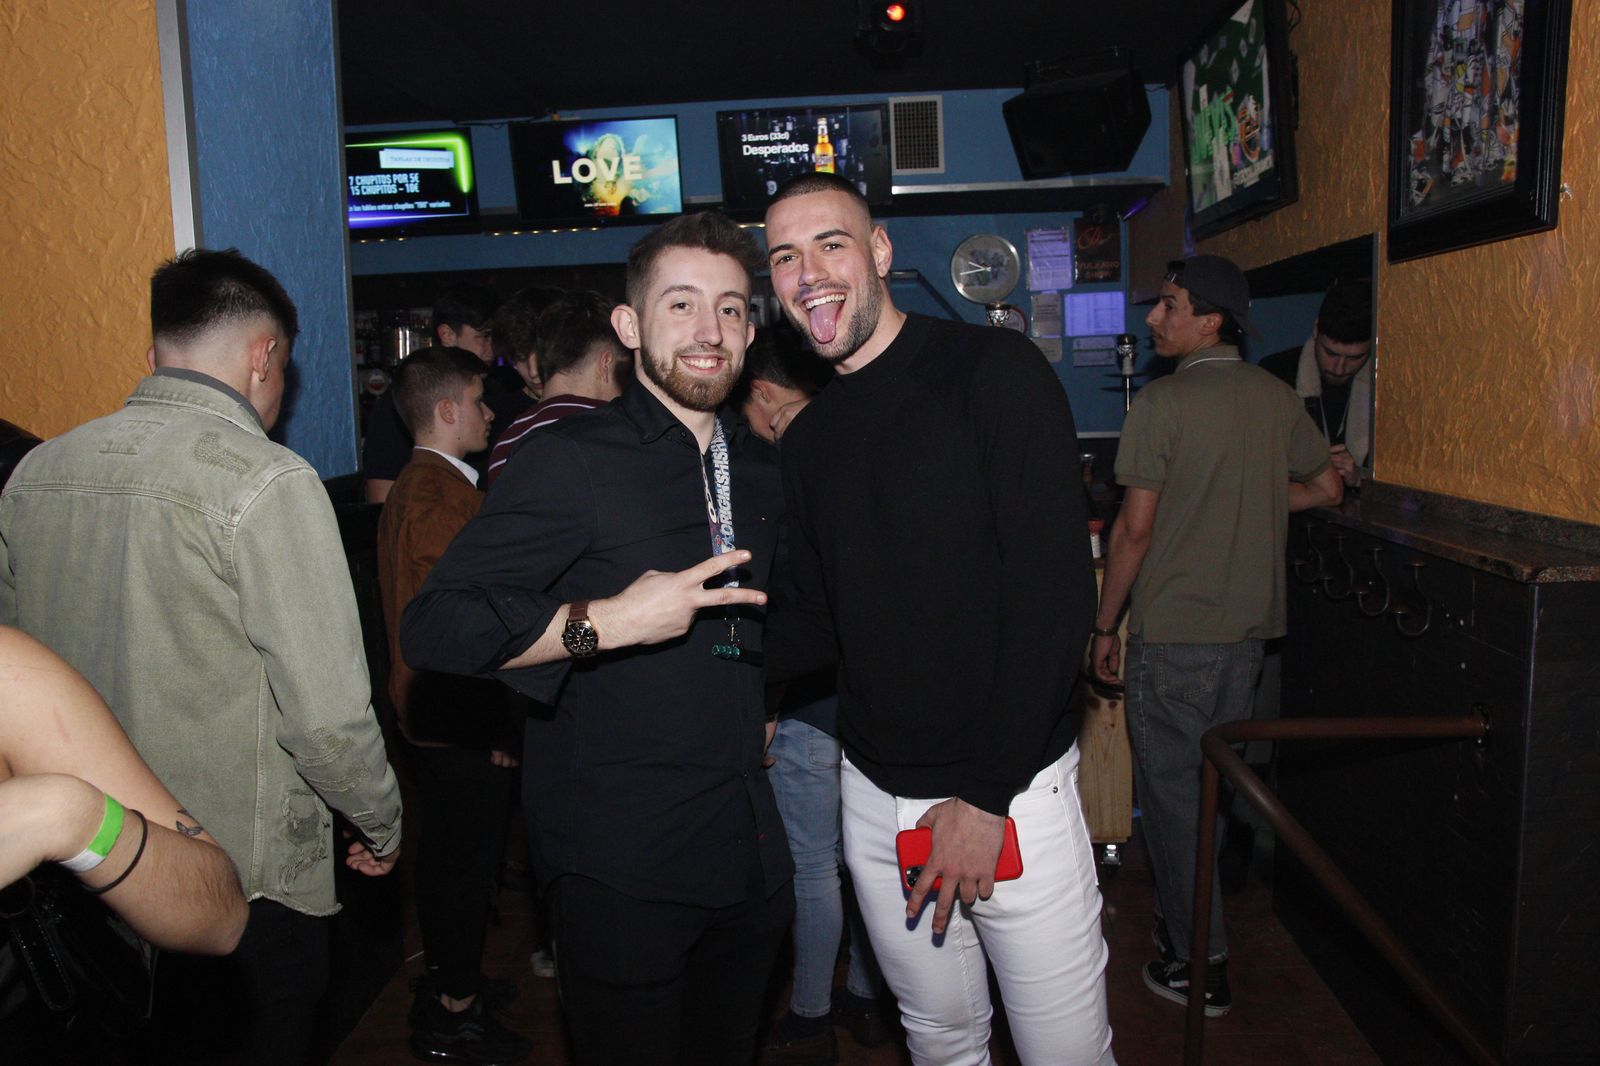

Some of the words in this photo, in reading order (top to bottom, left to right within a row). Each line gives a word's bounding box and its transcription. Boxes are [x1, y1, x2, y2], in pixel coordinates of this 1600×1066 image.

[741, 133, 748, 142] 3
[748, 133, 769, 142] Euros
[769, 131, 790, 141] (33cl)
[742, 141, 810, 158] Desperados
[552, 155, 643, 185] LOVE
[348, 175, 354, 186] 7
[355, 174, 392, 186] CHUPITOS
[392, 173, 409, 184] POR
[409, 172, 420, 183] 5€
[350, 185, 361, 196] 15
[361, 184, 398, 195] CHUPITOS
[405, 182, 420, 193] 10€
